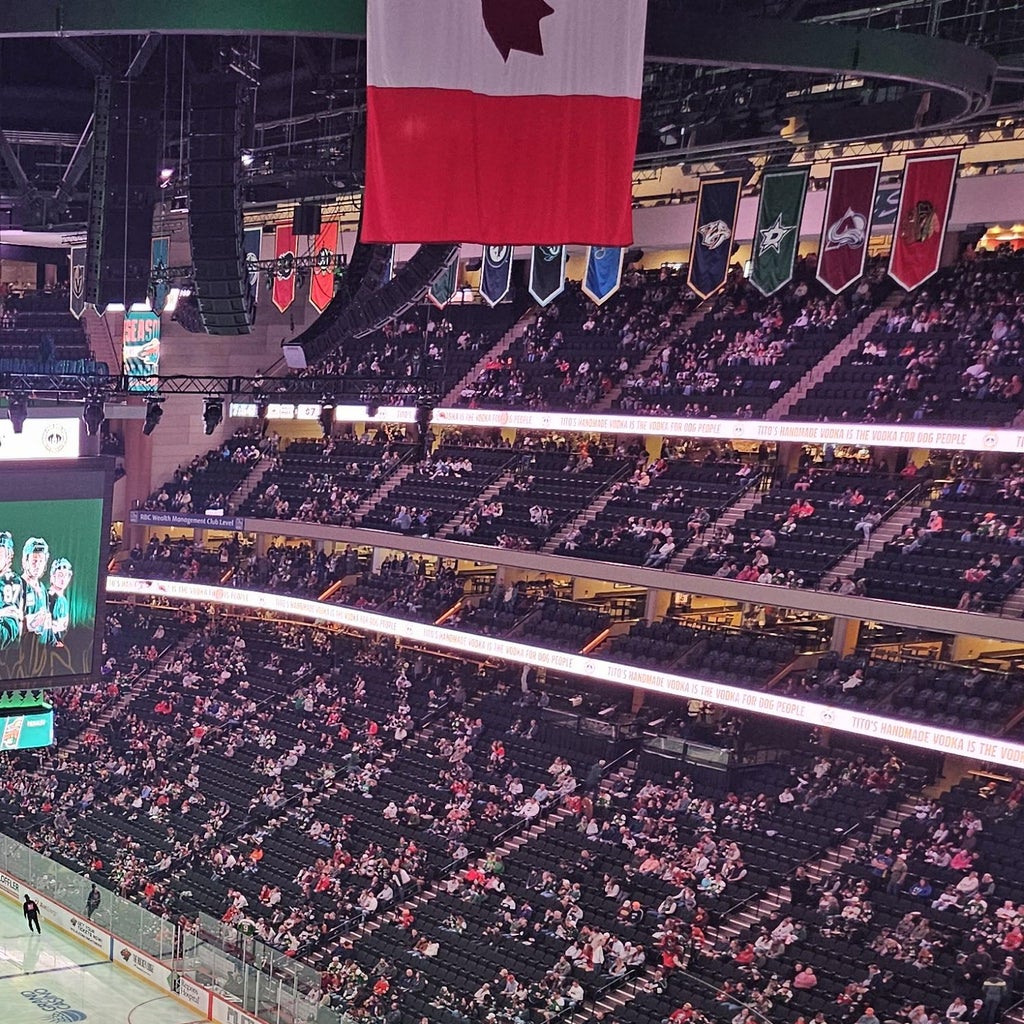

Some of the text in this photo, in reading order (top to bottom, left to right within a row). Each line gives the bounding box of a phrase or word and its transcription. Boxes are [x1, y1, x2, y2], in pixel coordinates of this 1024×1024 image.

[578, 417, 608, 428] HANDMADE
[609, 419, 628, 429] VODKA
[636, 420, 648, 430] THE
[649, 420, 669, 431] VODKA
[670, 421, 683, 432] FOR
[684, 422, 697, 433] DOG
[698, 423, 722, 434] PEOPLE
[757, 425, 778, 436] TITO'S
[779, 426, 818, 438] HANDMADE
[820, 427, 844, 440] VODKA
[856, 429, 869, 441] THE
[872, 430, 898, 442] VODKA
[899, 431, 915, 443] FOR
[917, 431, 934, 444] DOG
[935, 432, 967, 446] PEOPLE
[139, 513, 234, 527] RBC Wealth Management Club Level
[468, 638, 486, 650] VODKA
[506, 645, 525, 658] VODKA
[526, 649, 538, 660] FOR
[551, 654, 574, 670] PEOPLE
[607, 666, 627, 678] TITO'S
[629, 670, 665, 688] HANDMADE
[667, 679, 690, 693] VODKA
[700, 685, 714, 698] THE
[716, 688, 740, 703] VODKA
[742, 693, 758, 707] FOR
[759, 696, 775, 711] DOG
[776, 700, 806, 718] PEOPLE
[852, 715, 879, 733] TITO'S
[880, 723, 930, 744] HANDMADE
[932, 733, 965, 751] VODKA
[966, 739, 977, 754] IS
[979, 742, 998, 759] THE
[20, 989, 57, 1012] GRAND
[33, 987, 71, 1010] CASINO
